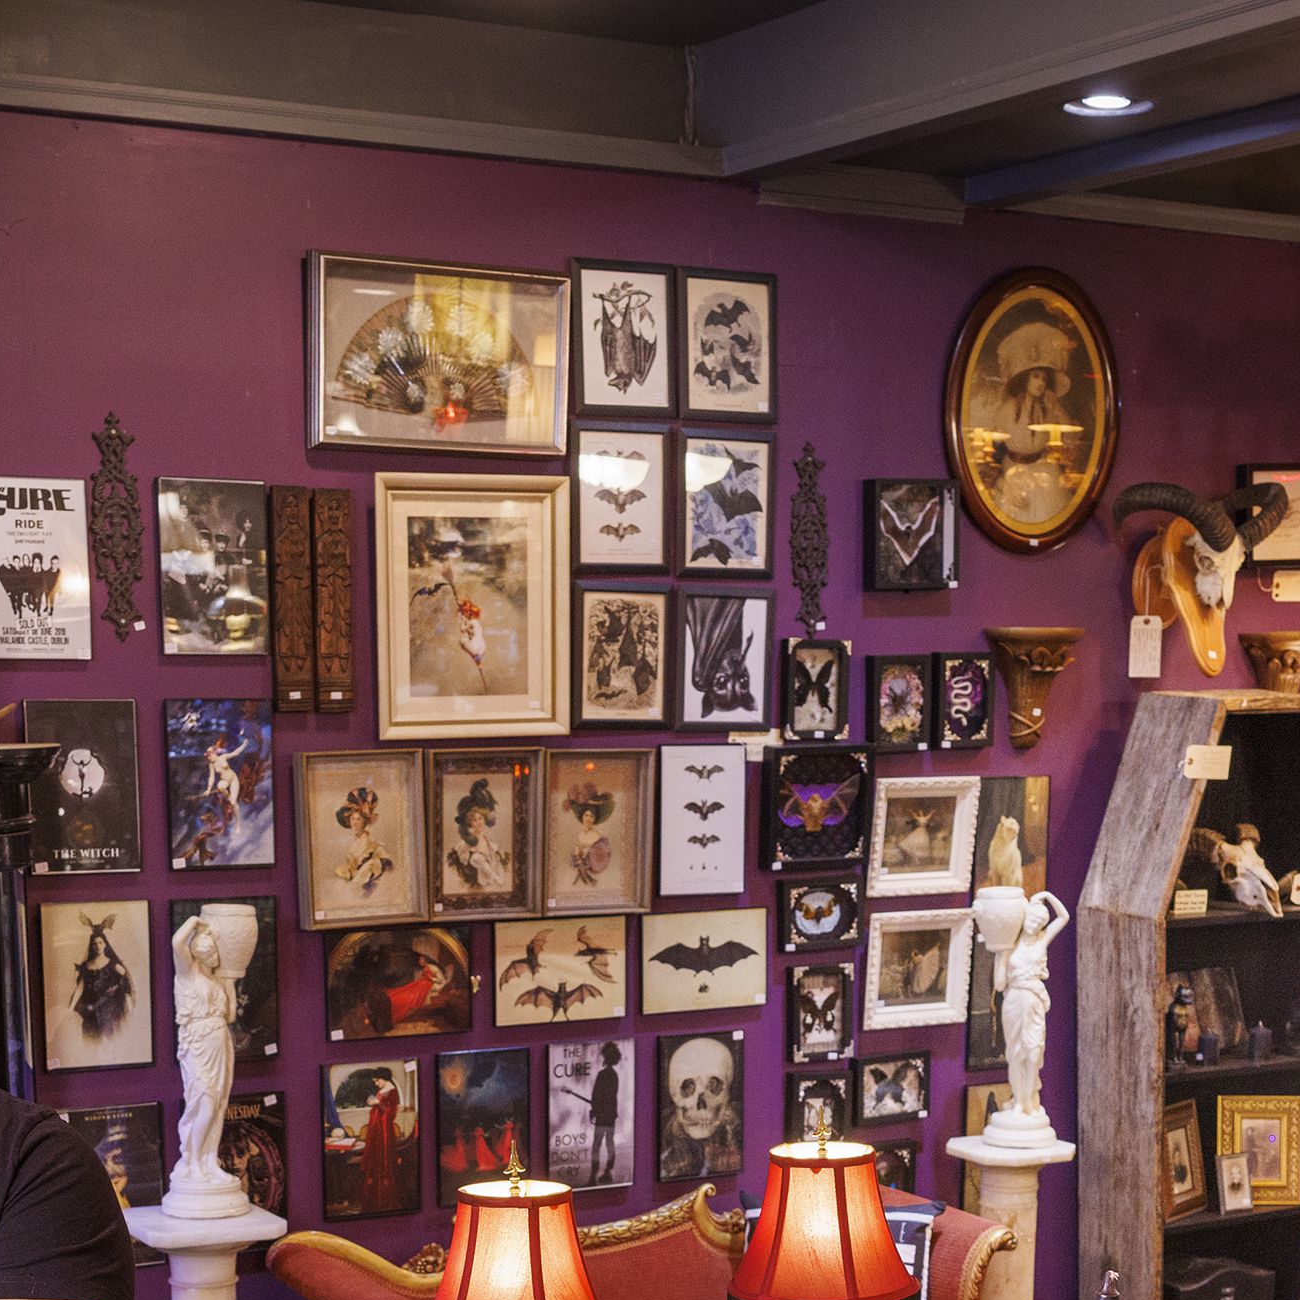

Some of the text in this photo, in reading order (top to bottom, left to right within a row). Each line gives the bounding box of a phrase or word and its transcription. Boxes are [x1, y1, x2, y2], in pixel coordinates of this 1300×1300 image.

[15, 519, 44, 529] RIDE
[19, 619, 35, 629] SOLD
[53, 848, 120, 859] THE WITCH
[563, 1047, 582, 1058] THE
[553, 1062, 592, 1078] CURE
[555, 1133, 587, 1146] BOYS
[551, 1148, 589, 1162] DON'T
[559, 1165, 581, 1177] CRY
